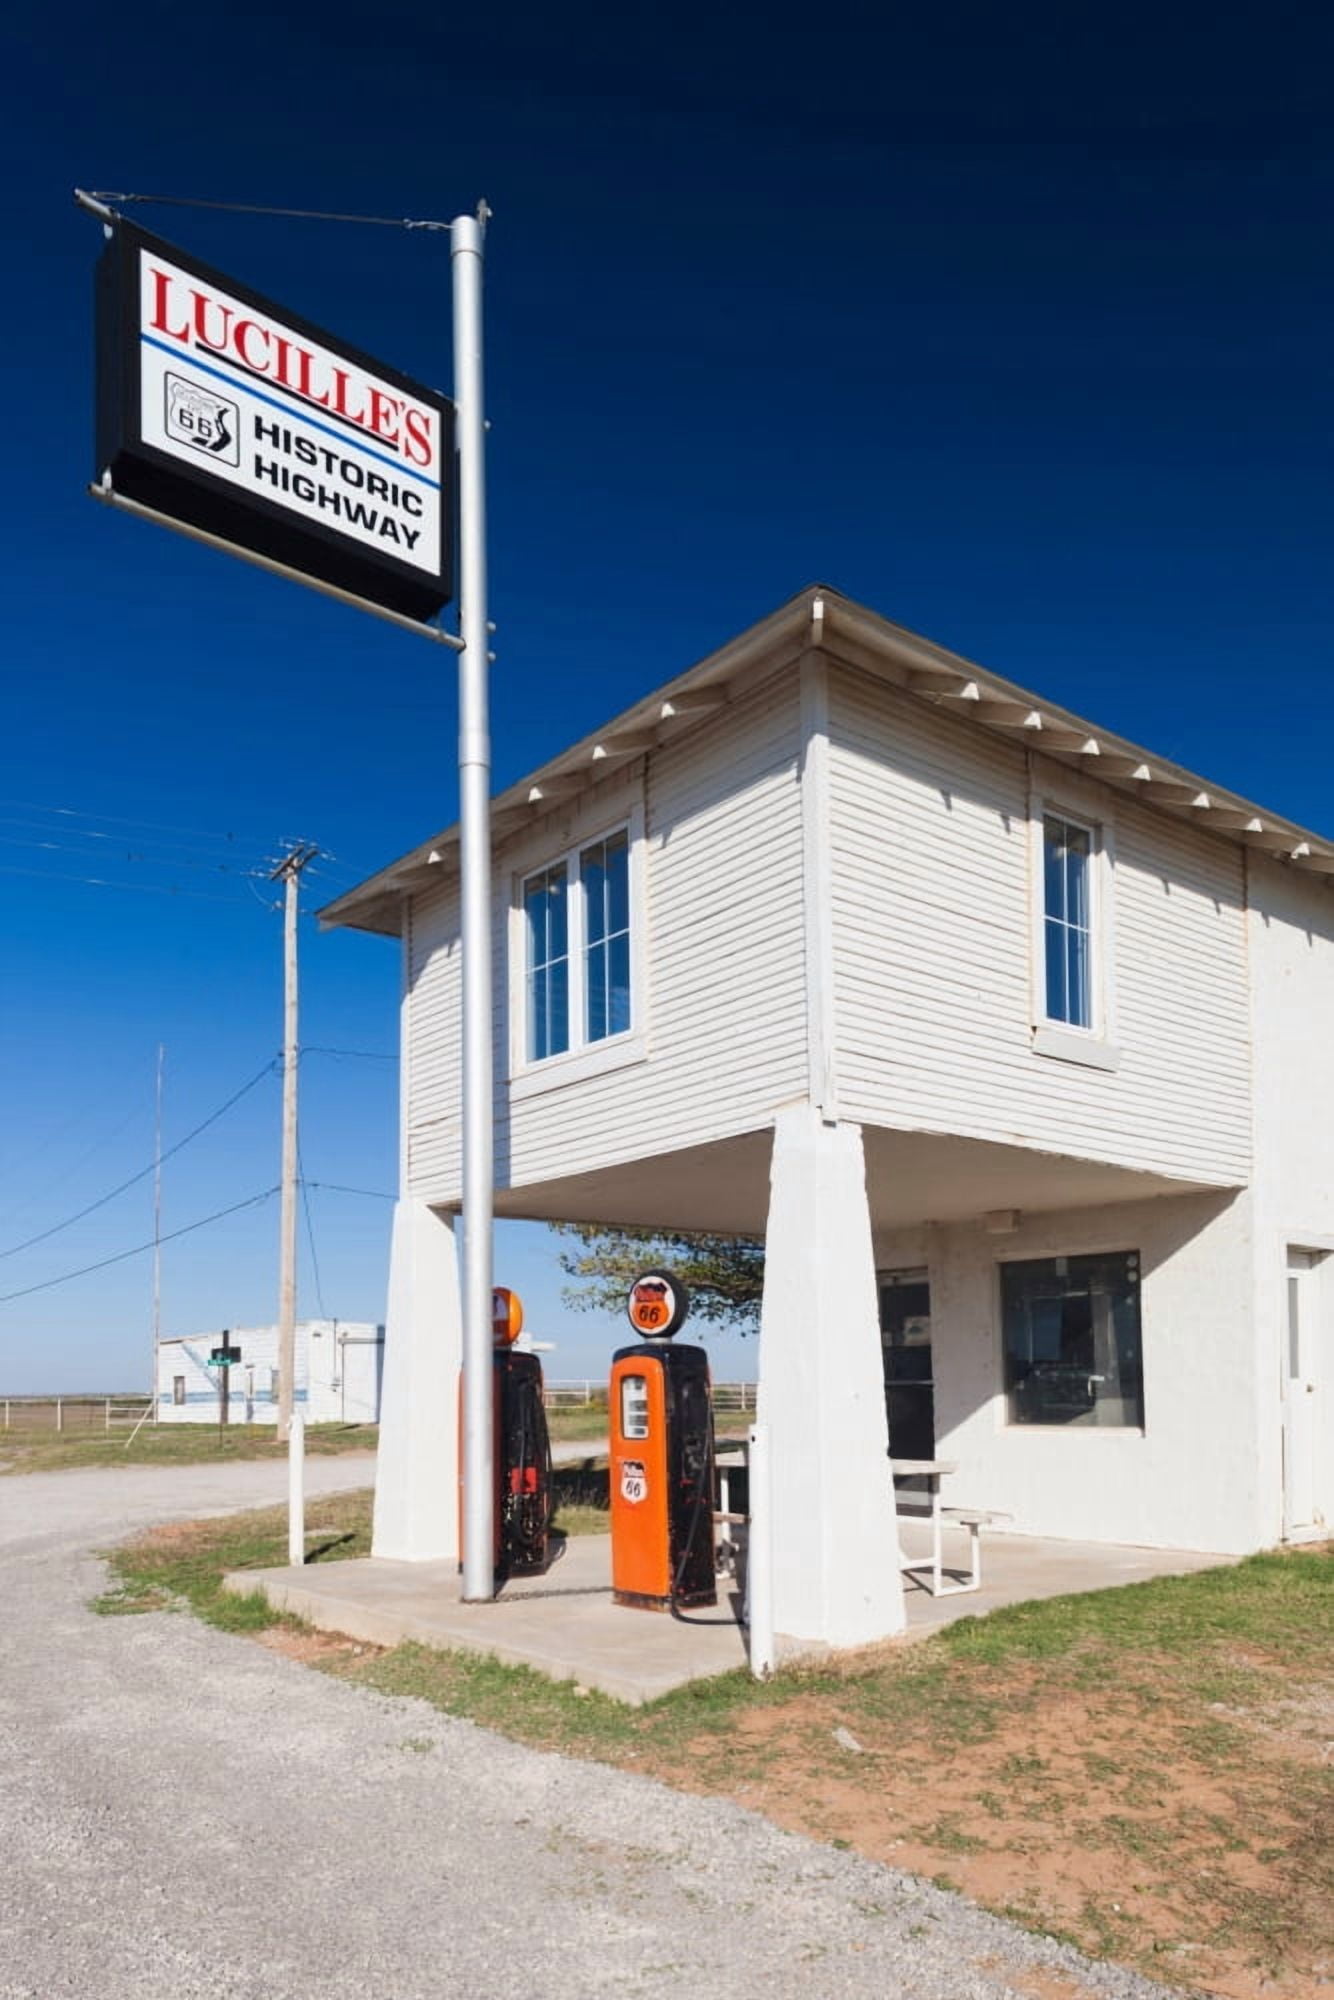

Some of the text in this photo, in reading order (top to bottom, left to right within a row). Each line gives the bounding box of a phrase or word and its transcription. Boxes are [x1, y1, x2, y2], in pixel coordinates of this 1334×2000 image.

[149, 267, 433, 468] LUCILLE'S
[180, 408, 213, 438] 66
[254, 414, 423, 518] HISTORIC
[254, 453, 421, 550] HIGHWAY
[639, 1304, 661, 1324] 66
[625, 1480, 641, 1498] 66
